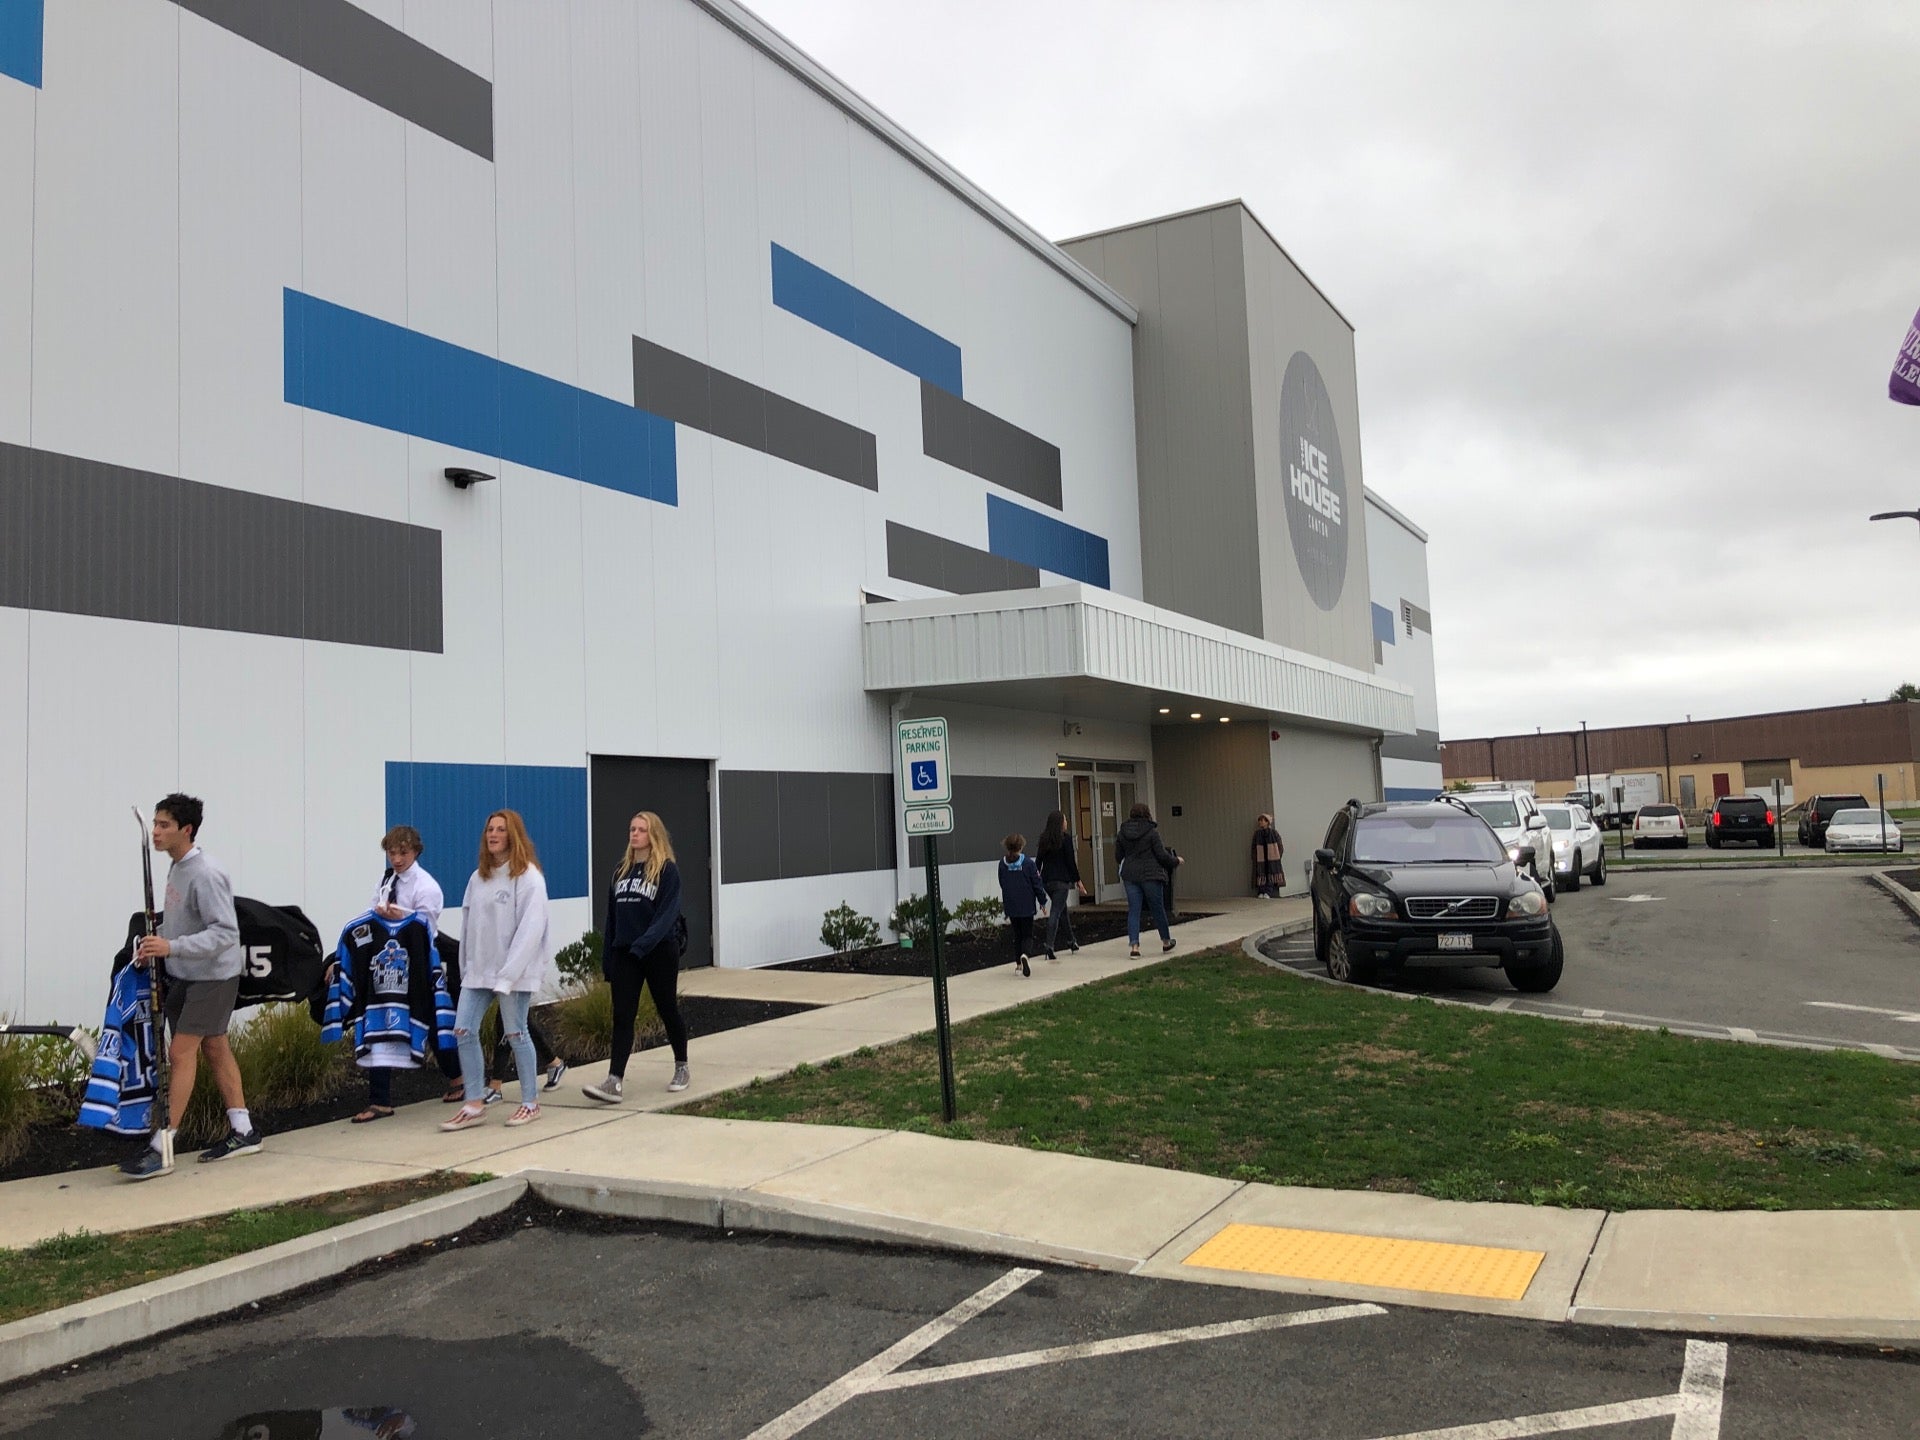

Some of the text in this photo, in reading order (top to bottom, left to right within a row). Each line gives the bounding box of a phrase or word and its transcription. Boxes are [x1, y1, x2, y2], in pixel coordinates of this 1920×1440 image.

[1303, 438, 1329, 485] ICE
[1289, 463, 1341, 526] HOUSE
[901, 726, 943, 740] RESERVED
[906, 740, 941, 754] PARKING
[912, 820, 946, 830] ACCESSIBLE
[920, 810, 936, 821] VAN
[240, 945, 272, 978] 15
[98, 1031, 122, 1059] 19
